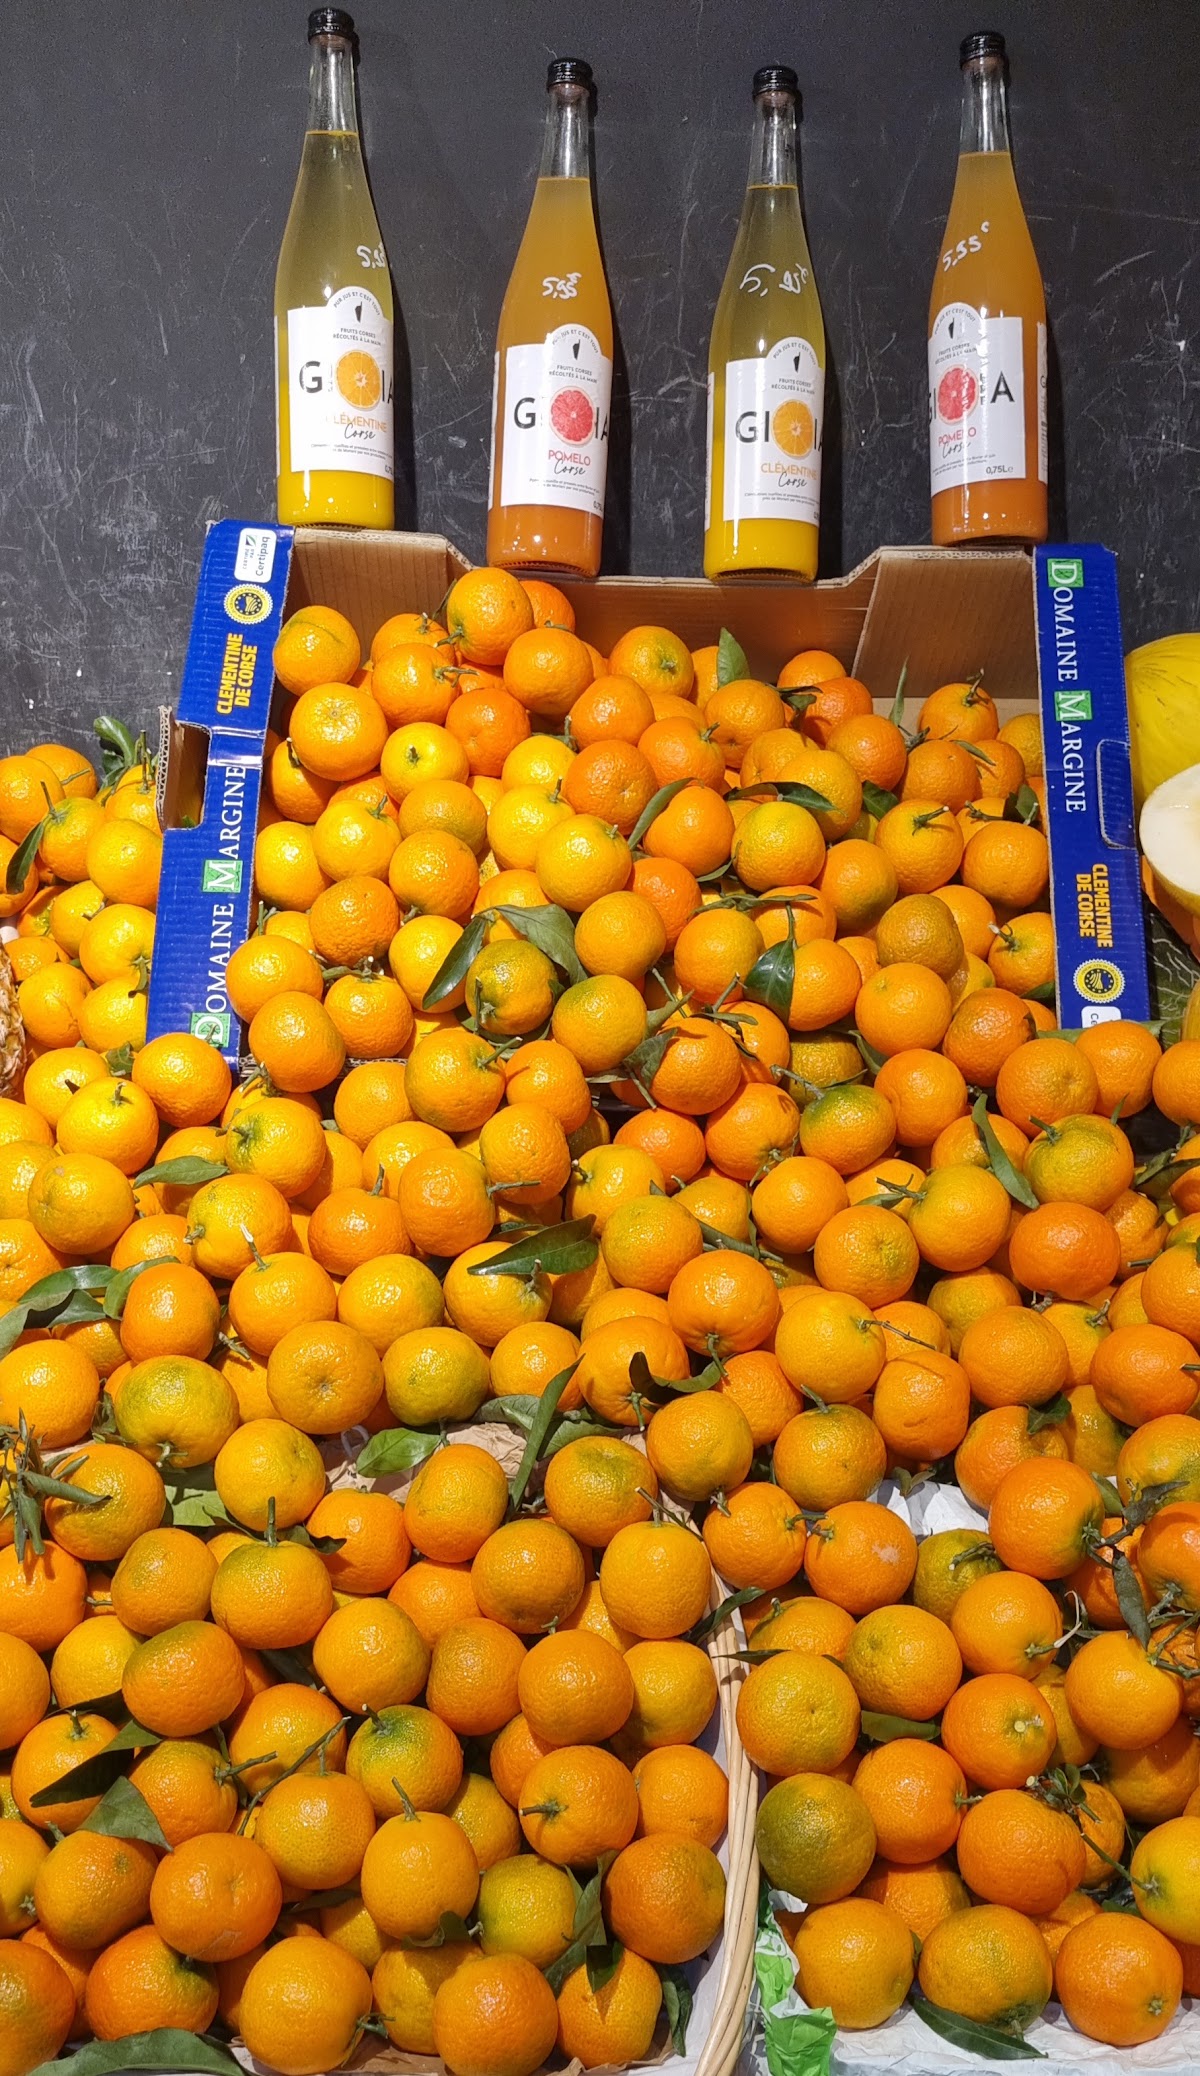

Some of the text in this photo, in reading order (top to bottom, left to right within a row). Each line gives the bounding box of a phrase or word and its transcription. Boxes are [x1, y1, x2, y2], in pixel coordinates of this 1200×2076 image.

[326, 411, 388, 433] LÉMENTINE
[344, 422, 376, 440] Corse
[938, 427, 976, 447] POMEO
[548, 449, 591, 466] POMELO
[554, 458, 586, 476] Corse
[760, 461, 817, 480] CLÉMENTINE
[778, 471, 808, 488] Corse
[256, 536, 270, 576] Certipaq
[216, 632, 244, 715] CLEMENTINE
[234, 645, 258, 708] DE CORSE
[1051, 562, 1087, 813] DOMAINE MARGINE
[194, 765, 246, 1044] DOMAINE MARGINE
[1076, 874, 1096, 938] DE CORSE
[1092, 864, 1113, 948] CLEMENTINE
